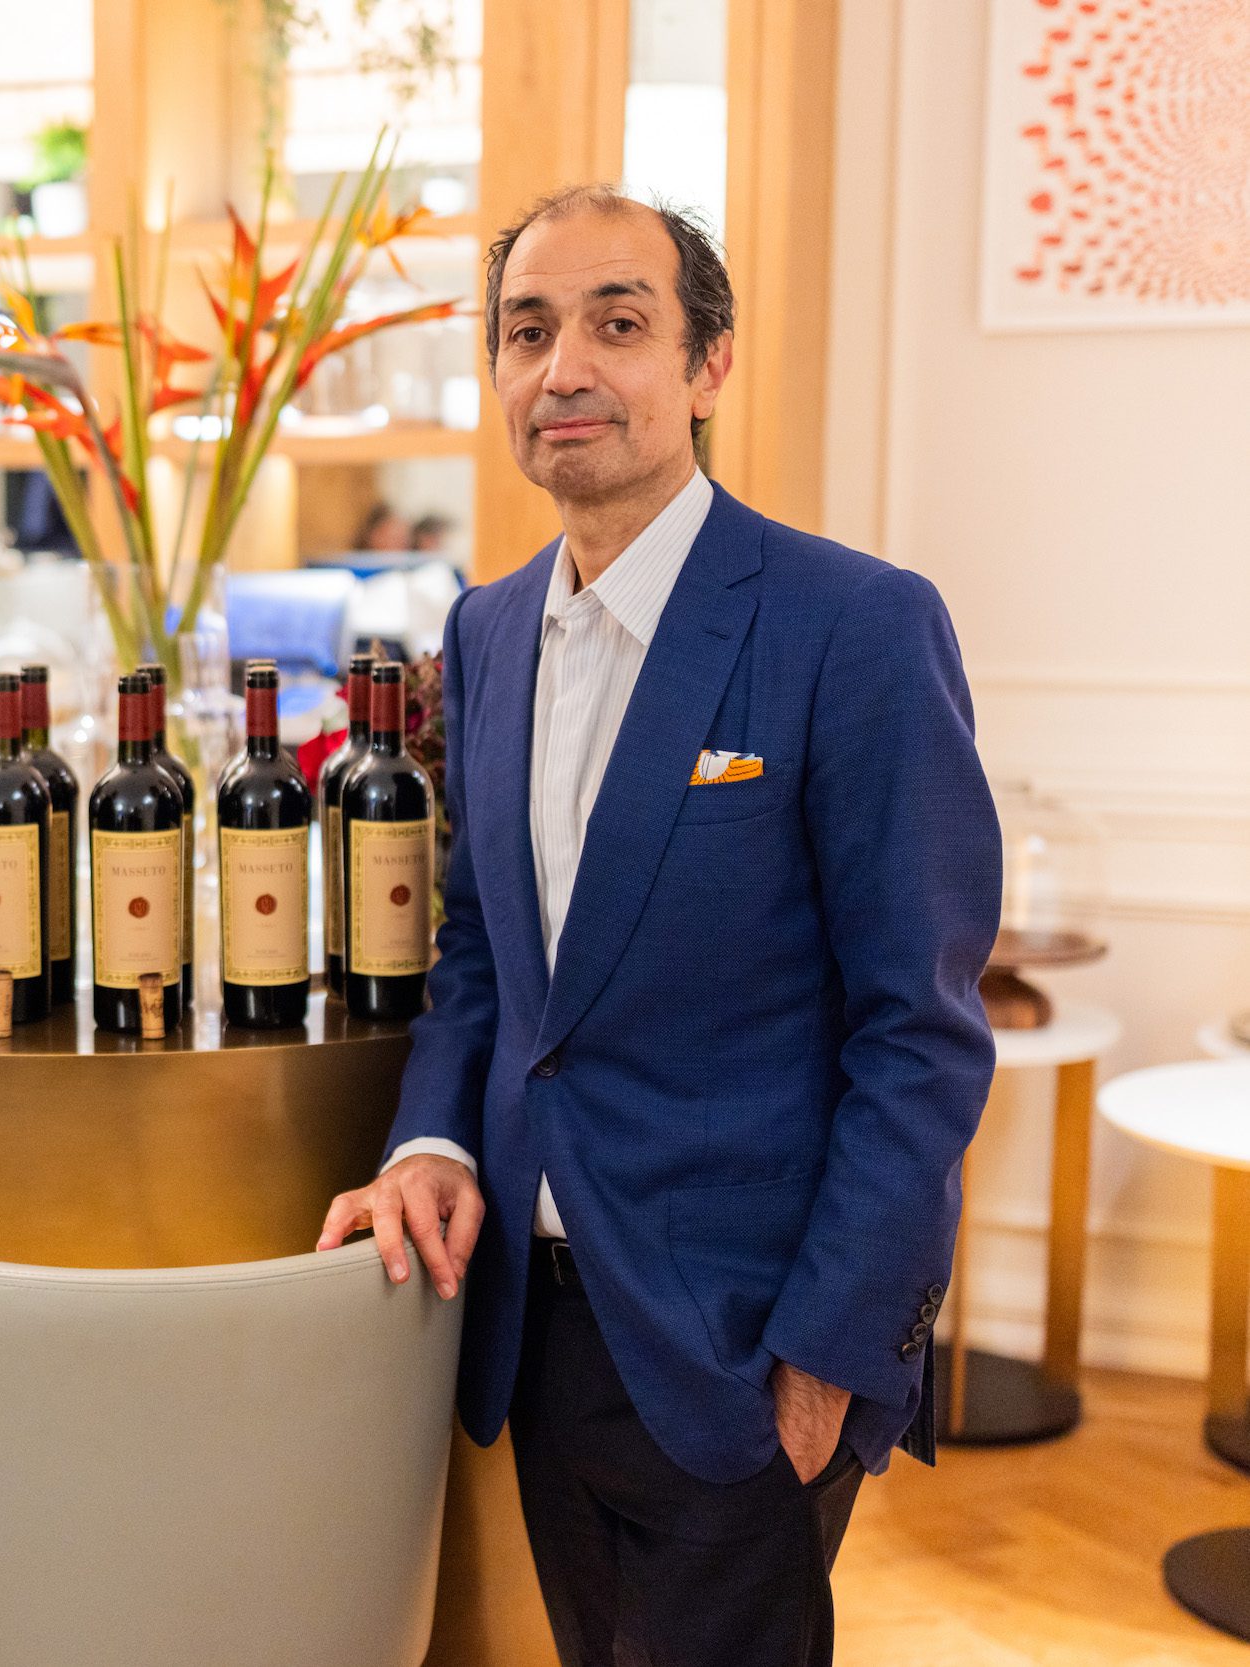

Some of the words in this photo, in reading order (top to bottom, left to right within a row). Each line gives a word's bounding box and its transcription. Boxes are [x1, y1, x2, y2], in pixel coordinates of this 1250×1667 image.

[373, 854, 426, 866] MASSETO
[111, 865, 167, 877] MASSETO
[238, 862, 294, 874] MASSETO
